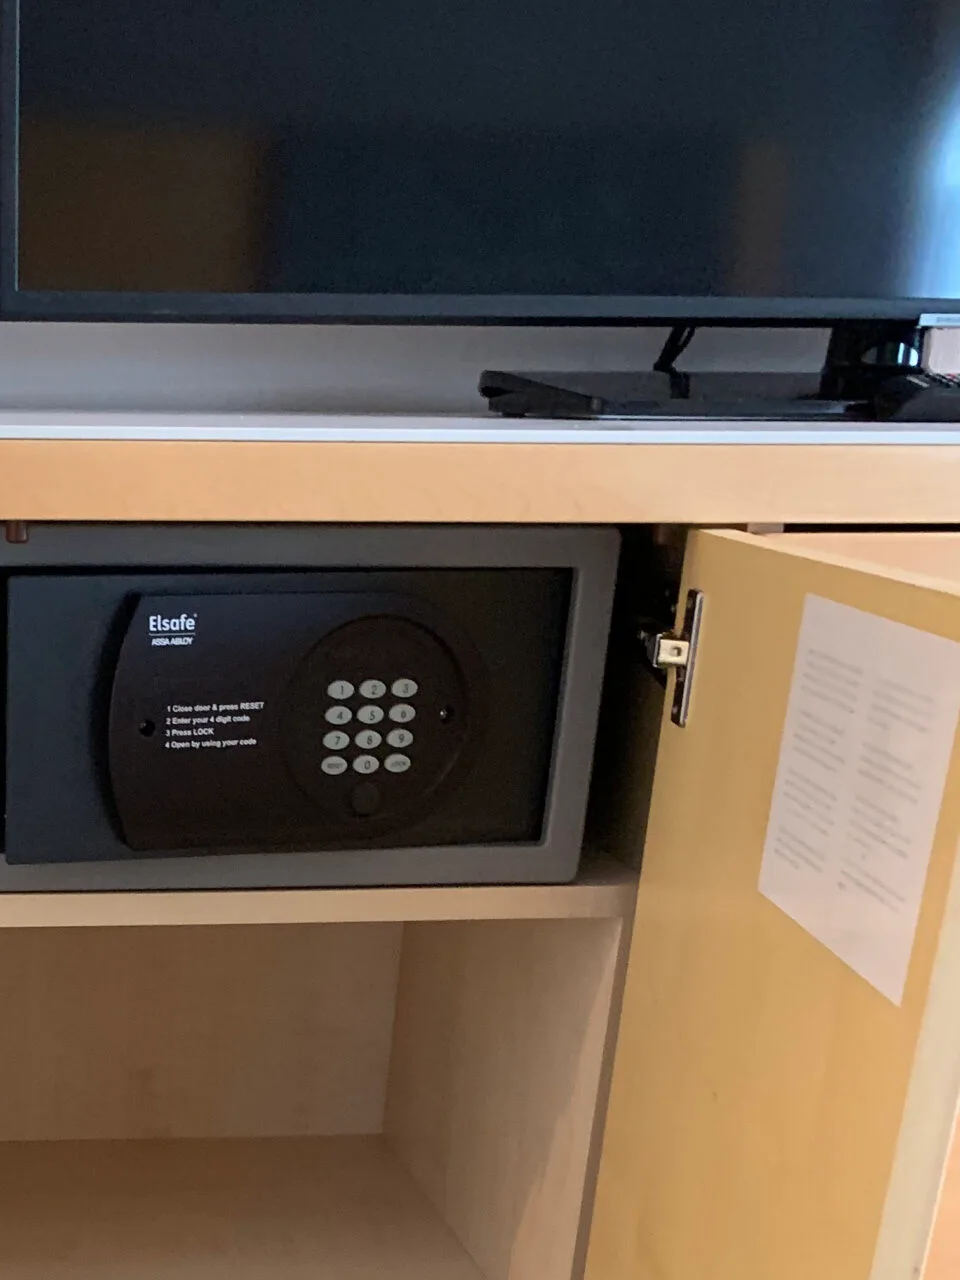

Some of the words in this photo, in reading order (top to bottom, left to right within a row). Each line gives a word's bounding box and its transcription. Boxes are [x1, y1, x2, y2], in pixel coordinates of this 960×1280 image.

[149, 613, 196, 631] Elsafe
[172, 705, 193, 713] Close
[194, 704, 211, 712] door
[212, 703, 218, 711] &
[218, 704, 239, 712] press
[240, 701, 264, 710] RESET
[172, 717, 192, 725] Enter
[192, 716, 209, 726] your
[215, 715, 232, 724] digit
[232, 714, 251, 722] code
[193, 727, 215, 736] LOCK
[164, 741, 170, 749] 4
[171, 741, 191, 749] Open
[191, 740, 201, 749] by
[201, 739, 221, 749] using
[221, 739, 239, 748] your
[239, 737, 257, 746] code
